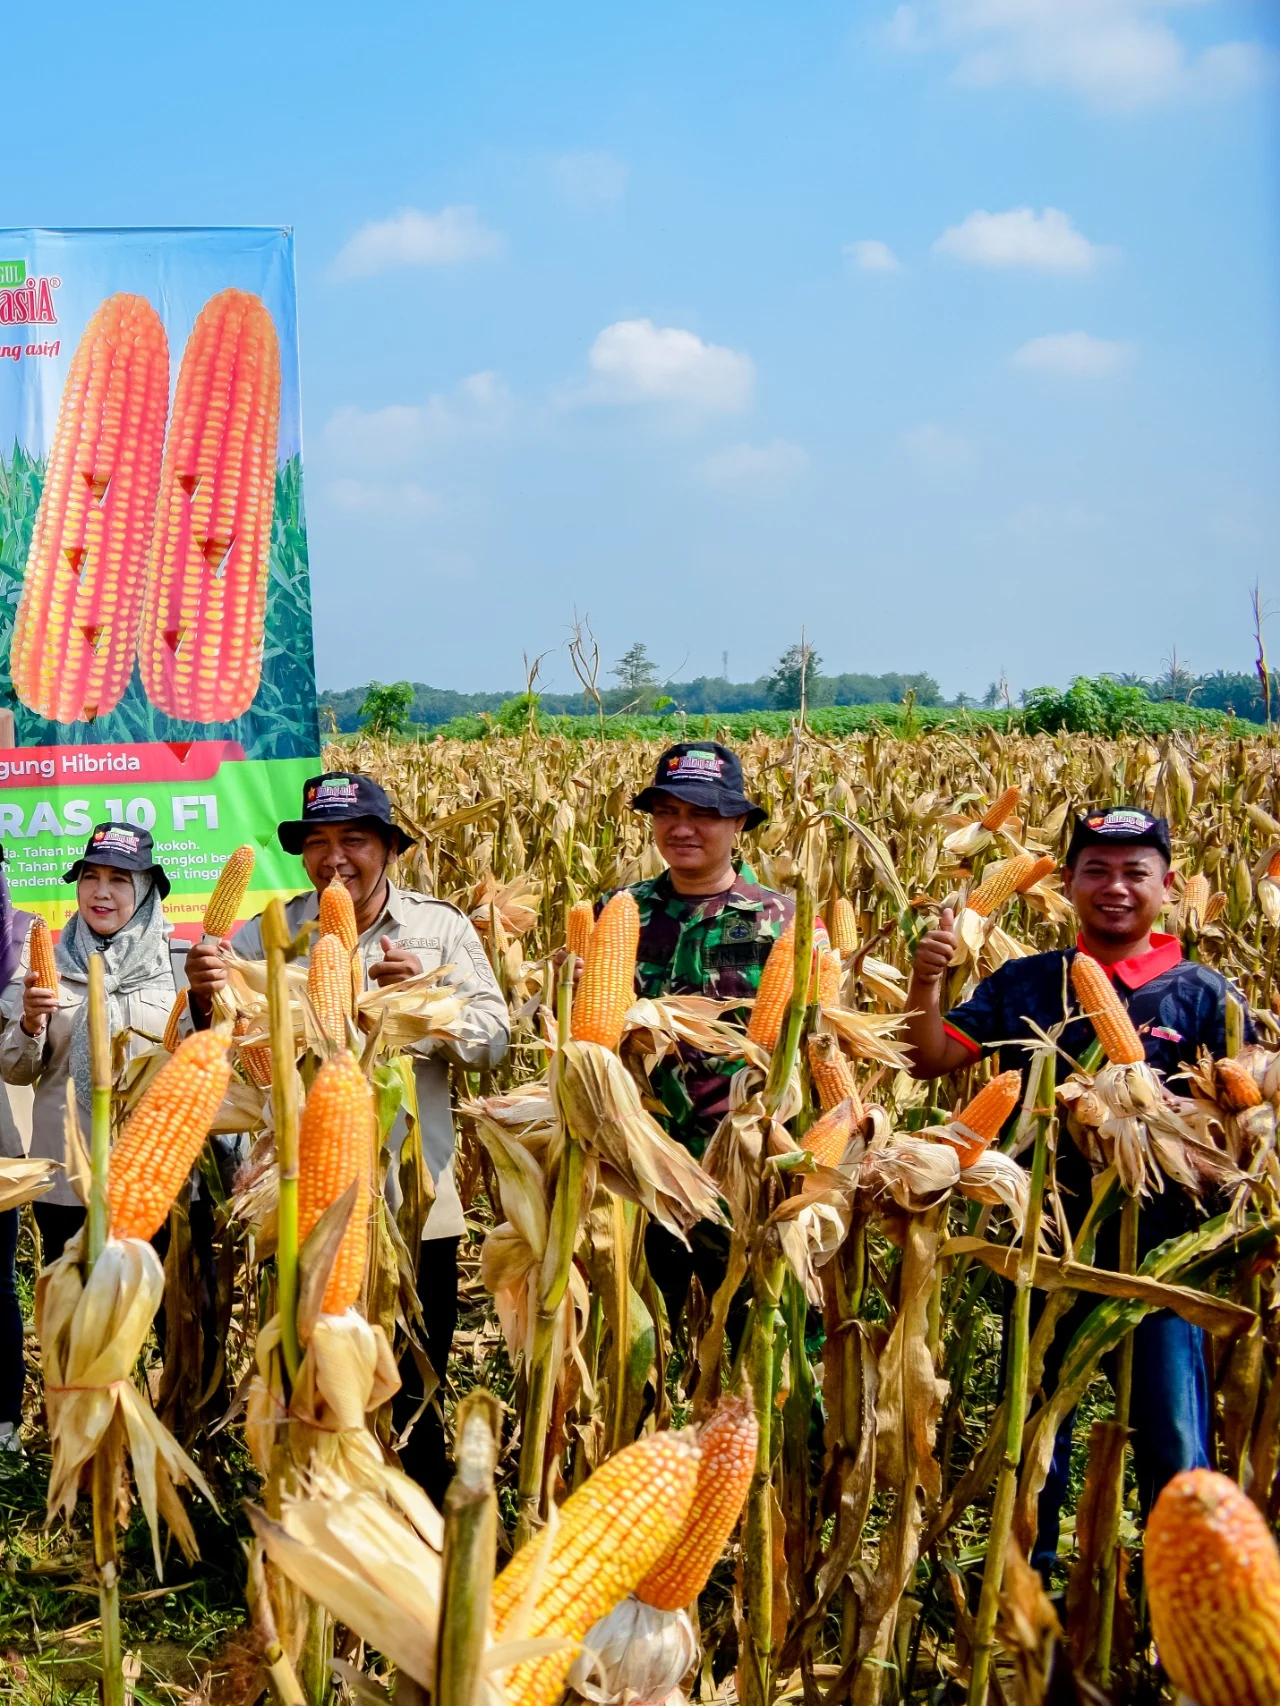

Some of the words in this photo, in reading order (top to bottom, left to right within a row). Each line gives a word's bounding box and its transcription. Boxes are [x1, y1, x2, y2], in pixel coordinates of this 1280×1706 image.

[62, 753, 140, 773] Hibrida
[105, 797, 157, 832] 10
[172, 794, 219, 831] F1
[156, 840, 200, 851] kokoh.
[23, 846, 63, 857] Tahan
[155, 854, 207, 866] Tongkol
[17, 861, 58, 872] Tahan
